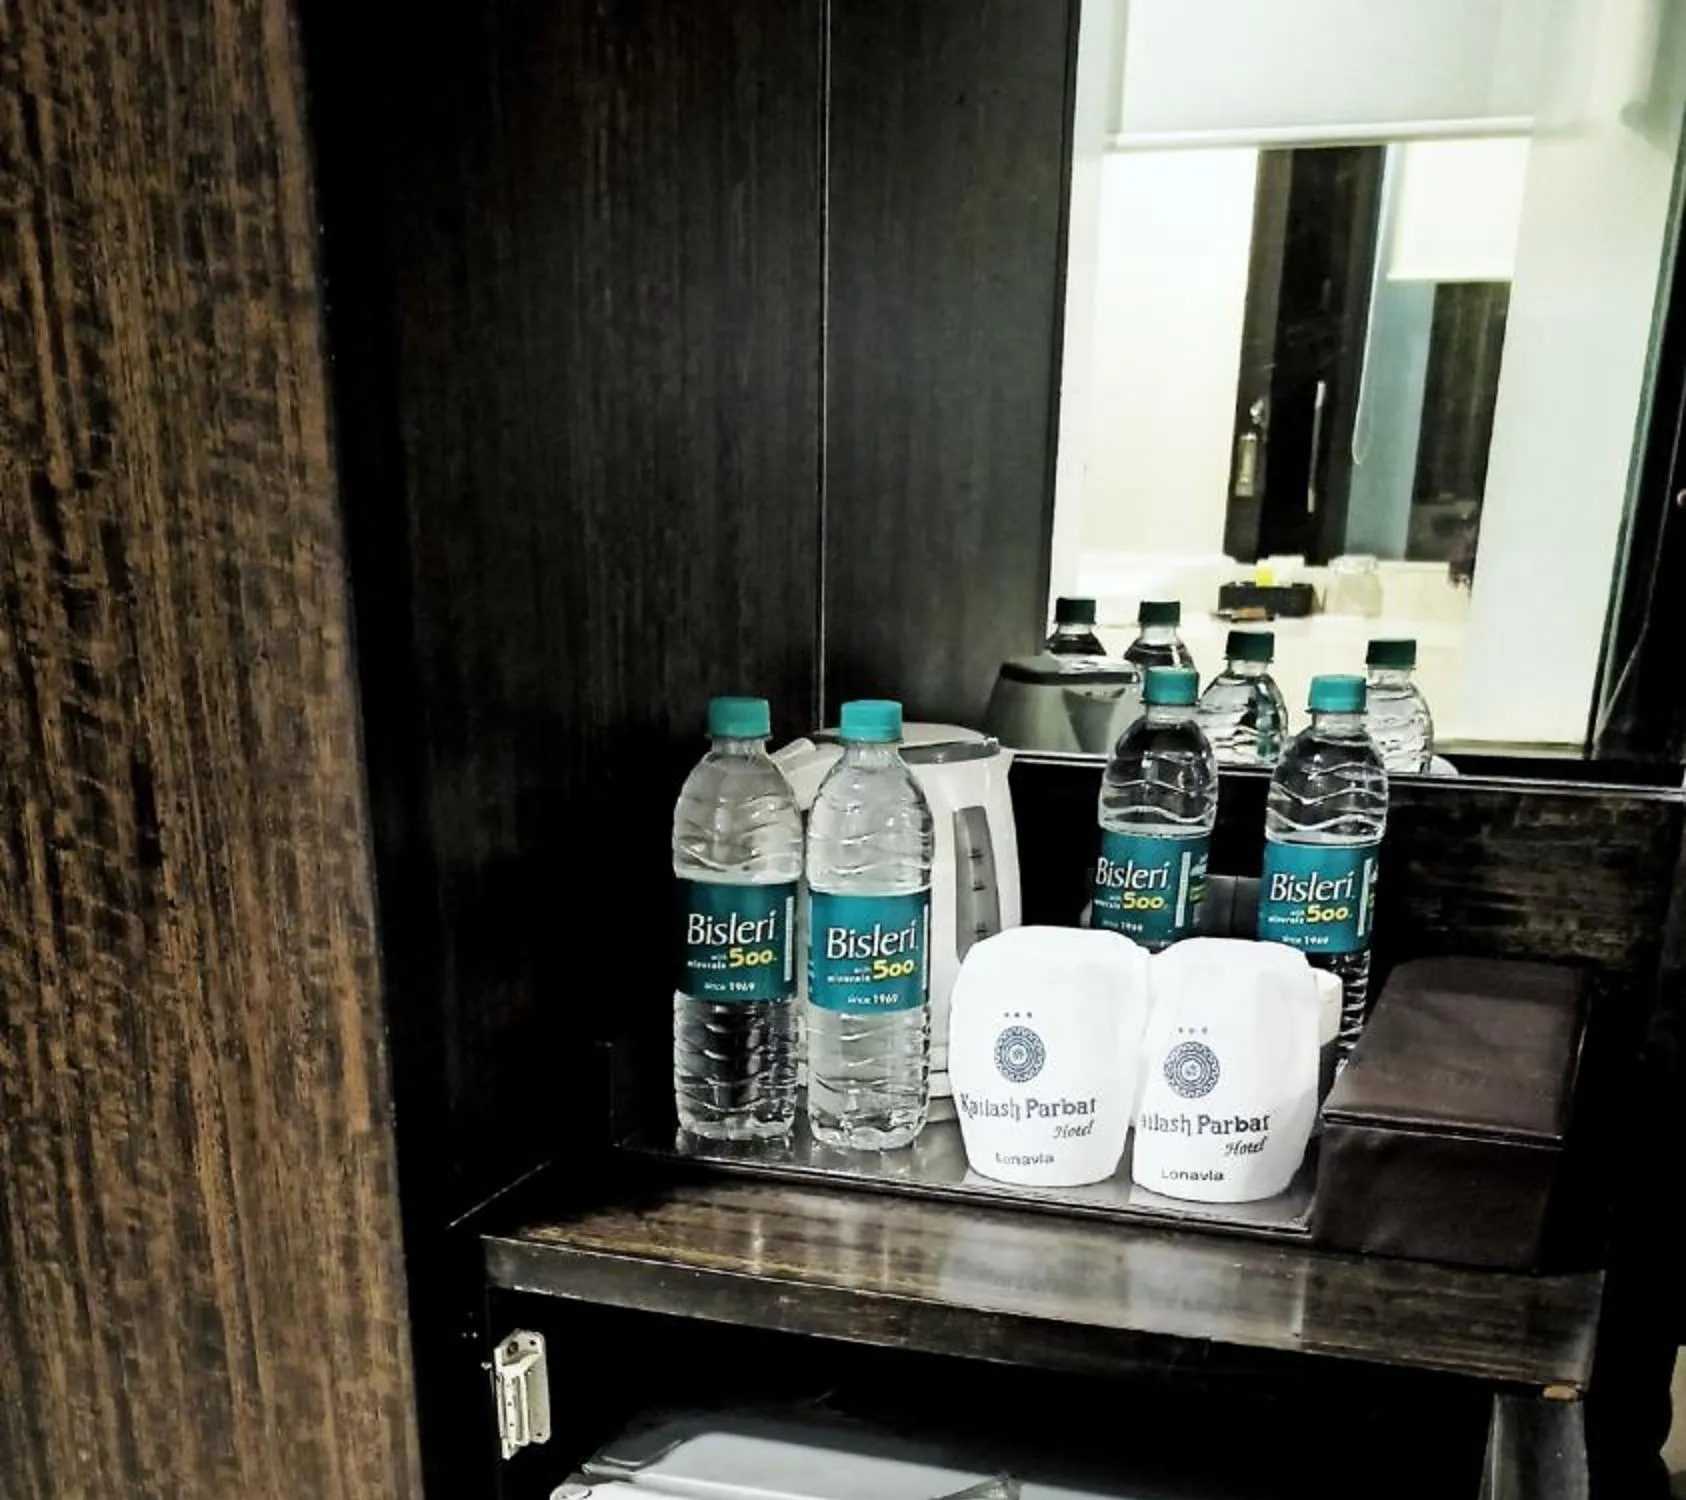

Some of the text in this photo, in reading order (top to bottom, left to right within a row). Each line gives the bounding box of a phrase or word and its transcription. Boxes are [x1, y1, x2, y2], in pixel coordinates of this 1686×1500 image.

[1095, 856, 1169, 889] Bisleri
[1269, 870, 1354, 903] Bisleri
[1123, 891, 1165, 909] 500
[1306, 904, 1349, 922] 500
[687, 909, 777, 945] Bisleri
[826, 919, 916, 959] Bisleri
[729, 947, 773, 968] 500
[873, 959, 914, 979] 500
[729, 981, 755, 991] 1969
[1161, 1166, 1224, 1181] Lonavla
